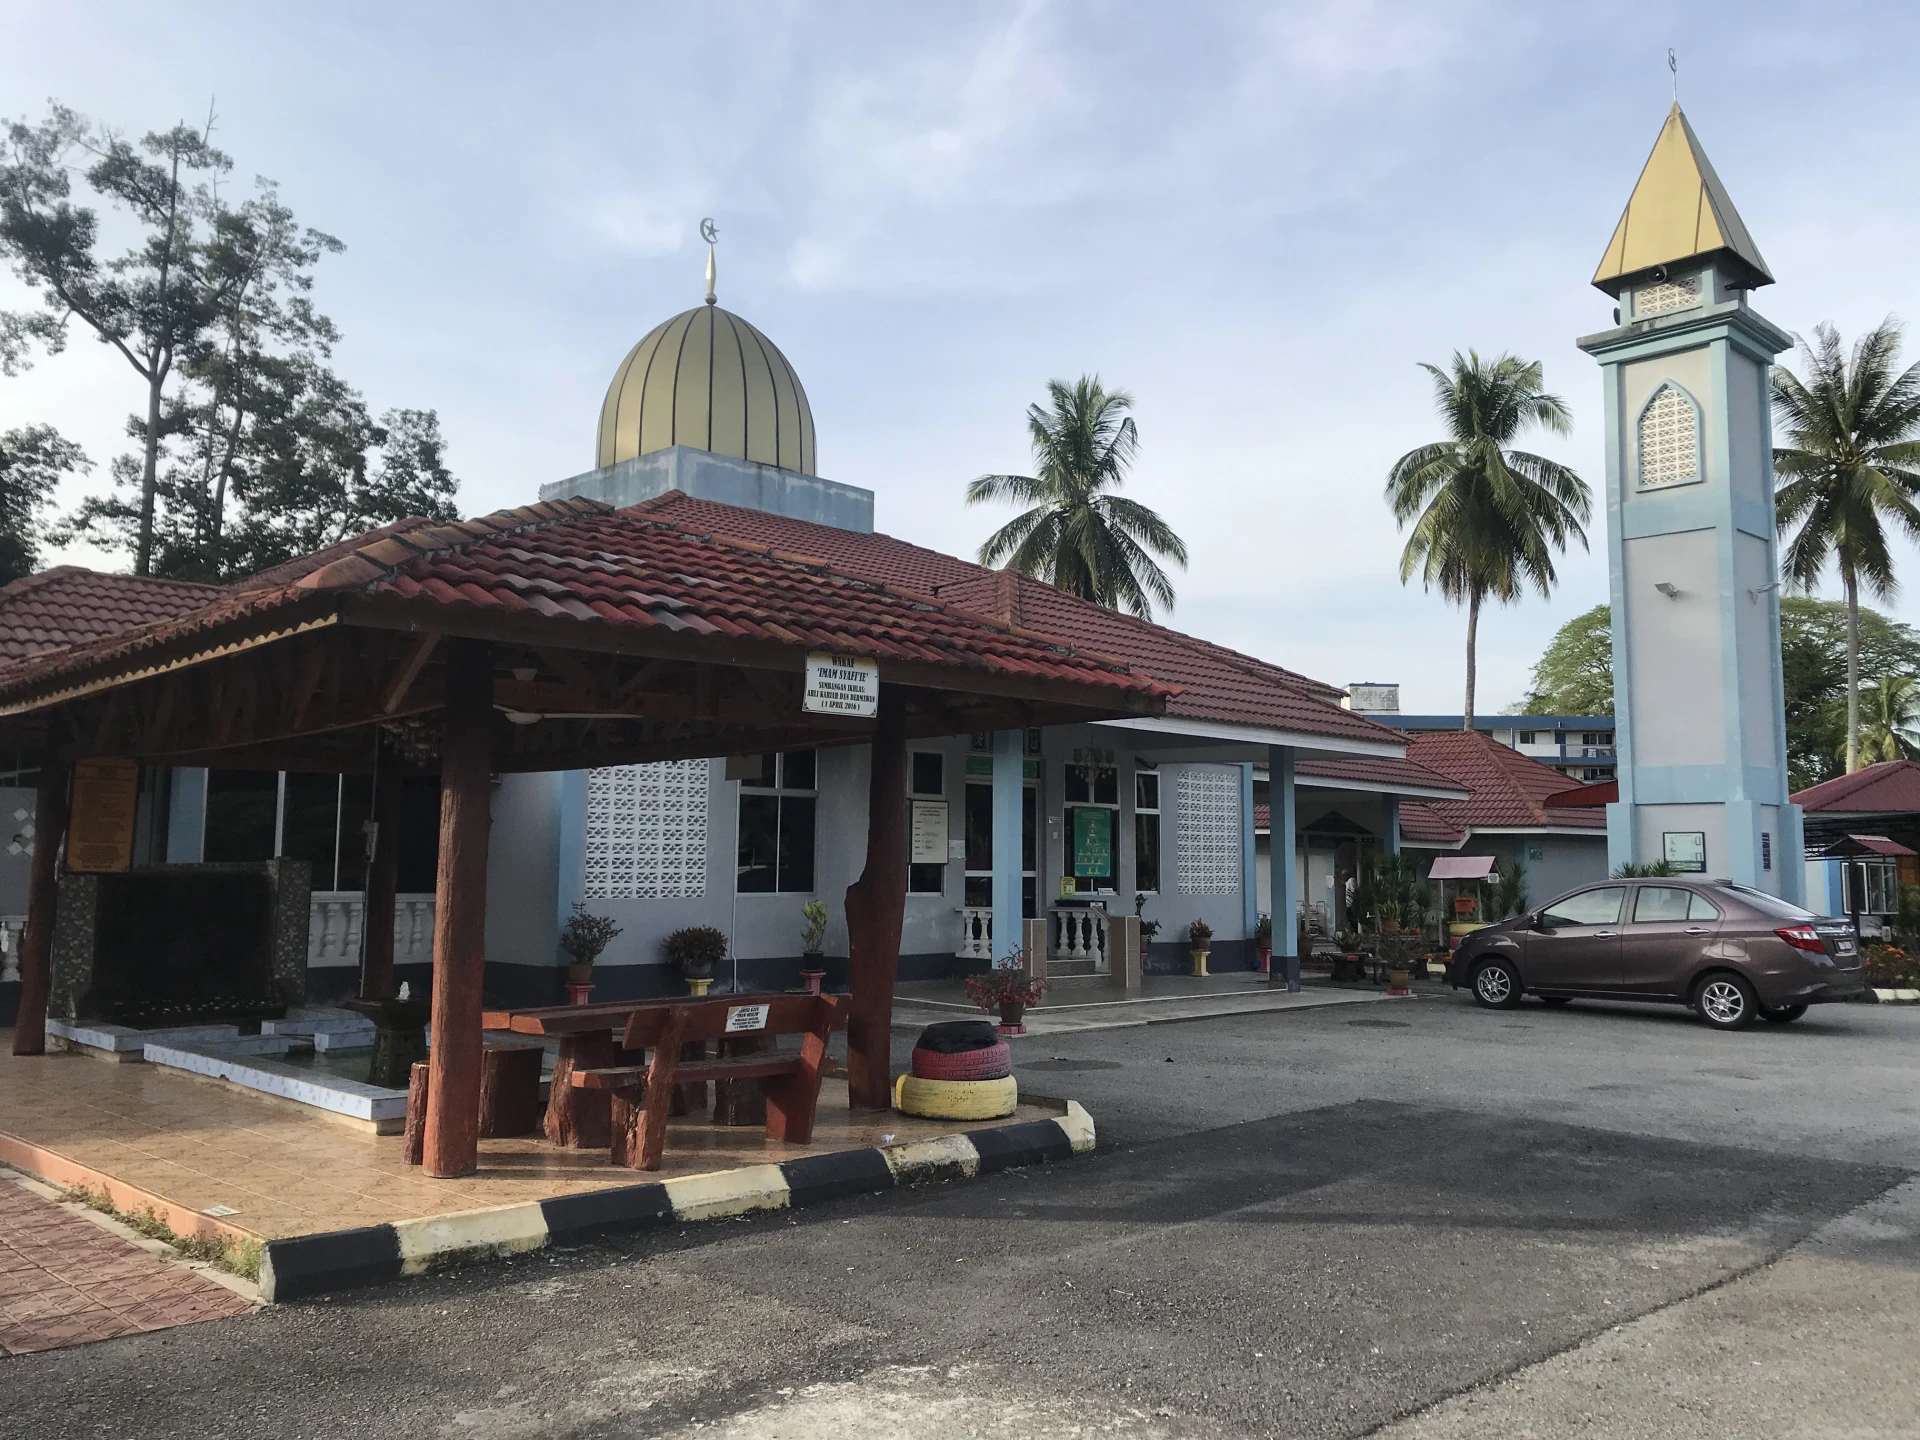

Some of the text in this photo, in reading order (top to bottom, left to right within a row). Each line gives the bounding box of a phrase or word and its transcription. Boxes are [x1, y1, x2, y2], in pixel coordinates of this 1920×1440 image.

[831, 656, 855, 668] WAKAF
[818, 681, 846, 691] SUMBANGAN
[807, 689, 819, 697] AHLI
[819, 690, 839, 699] KARIAH
[839, 692, 849, 700] DAN
[829, 700, 843, 709] APRIL
